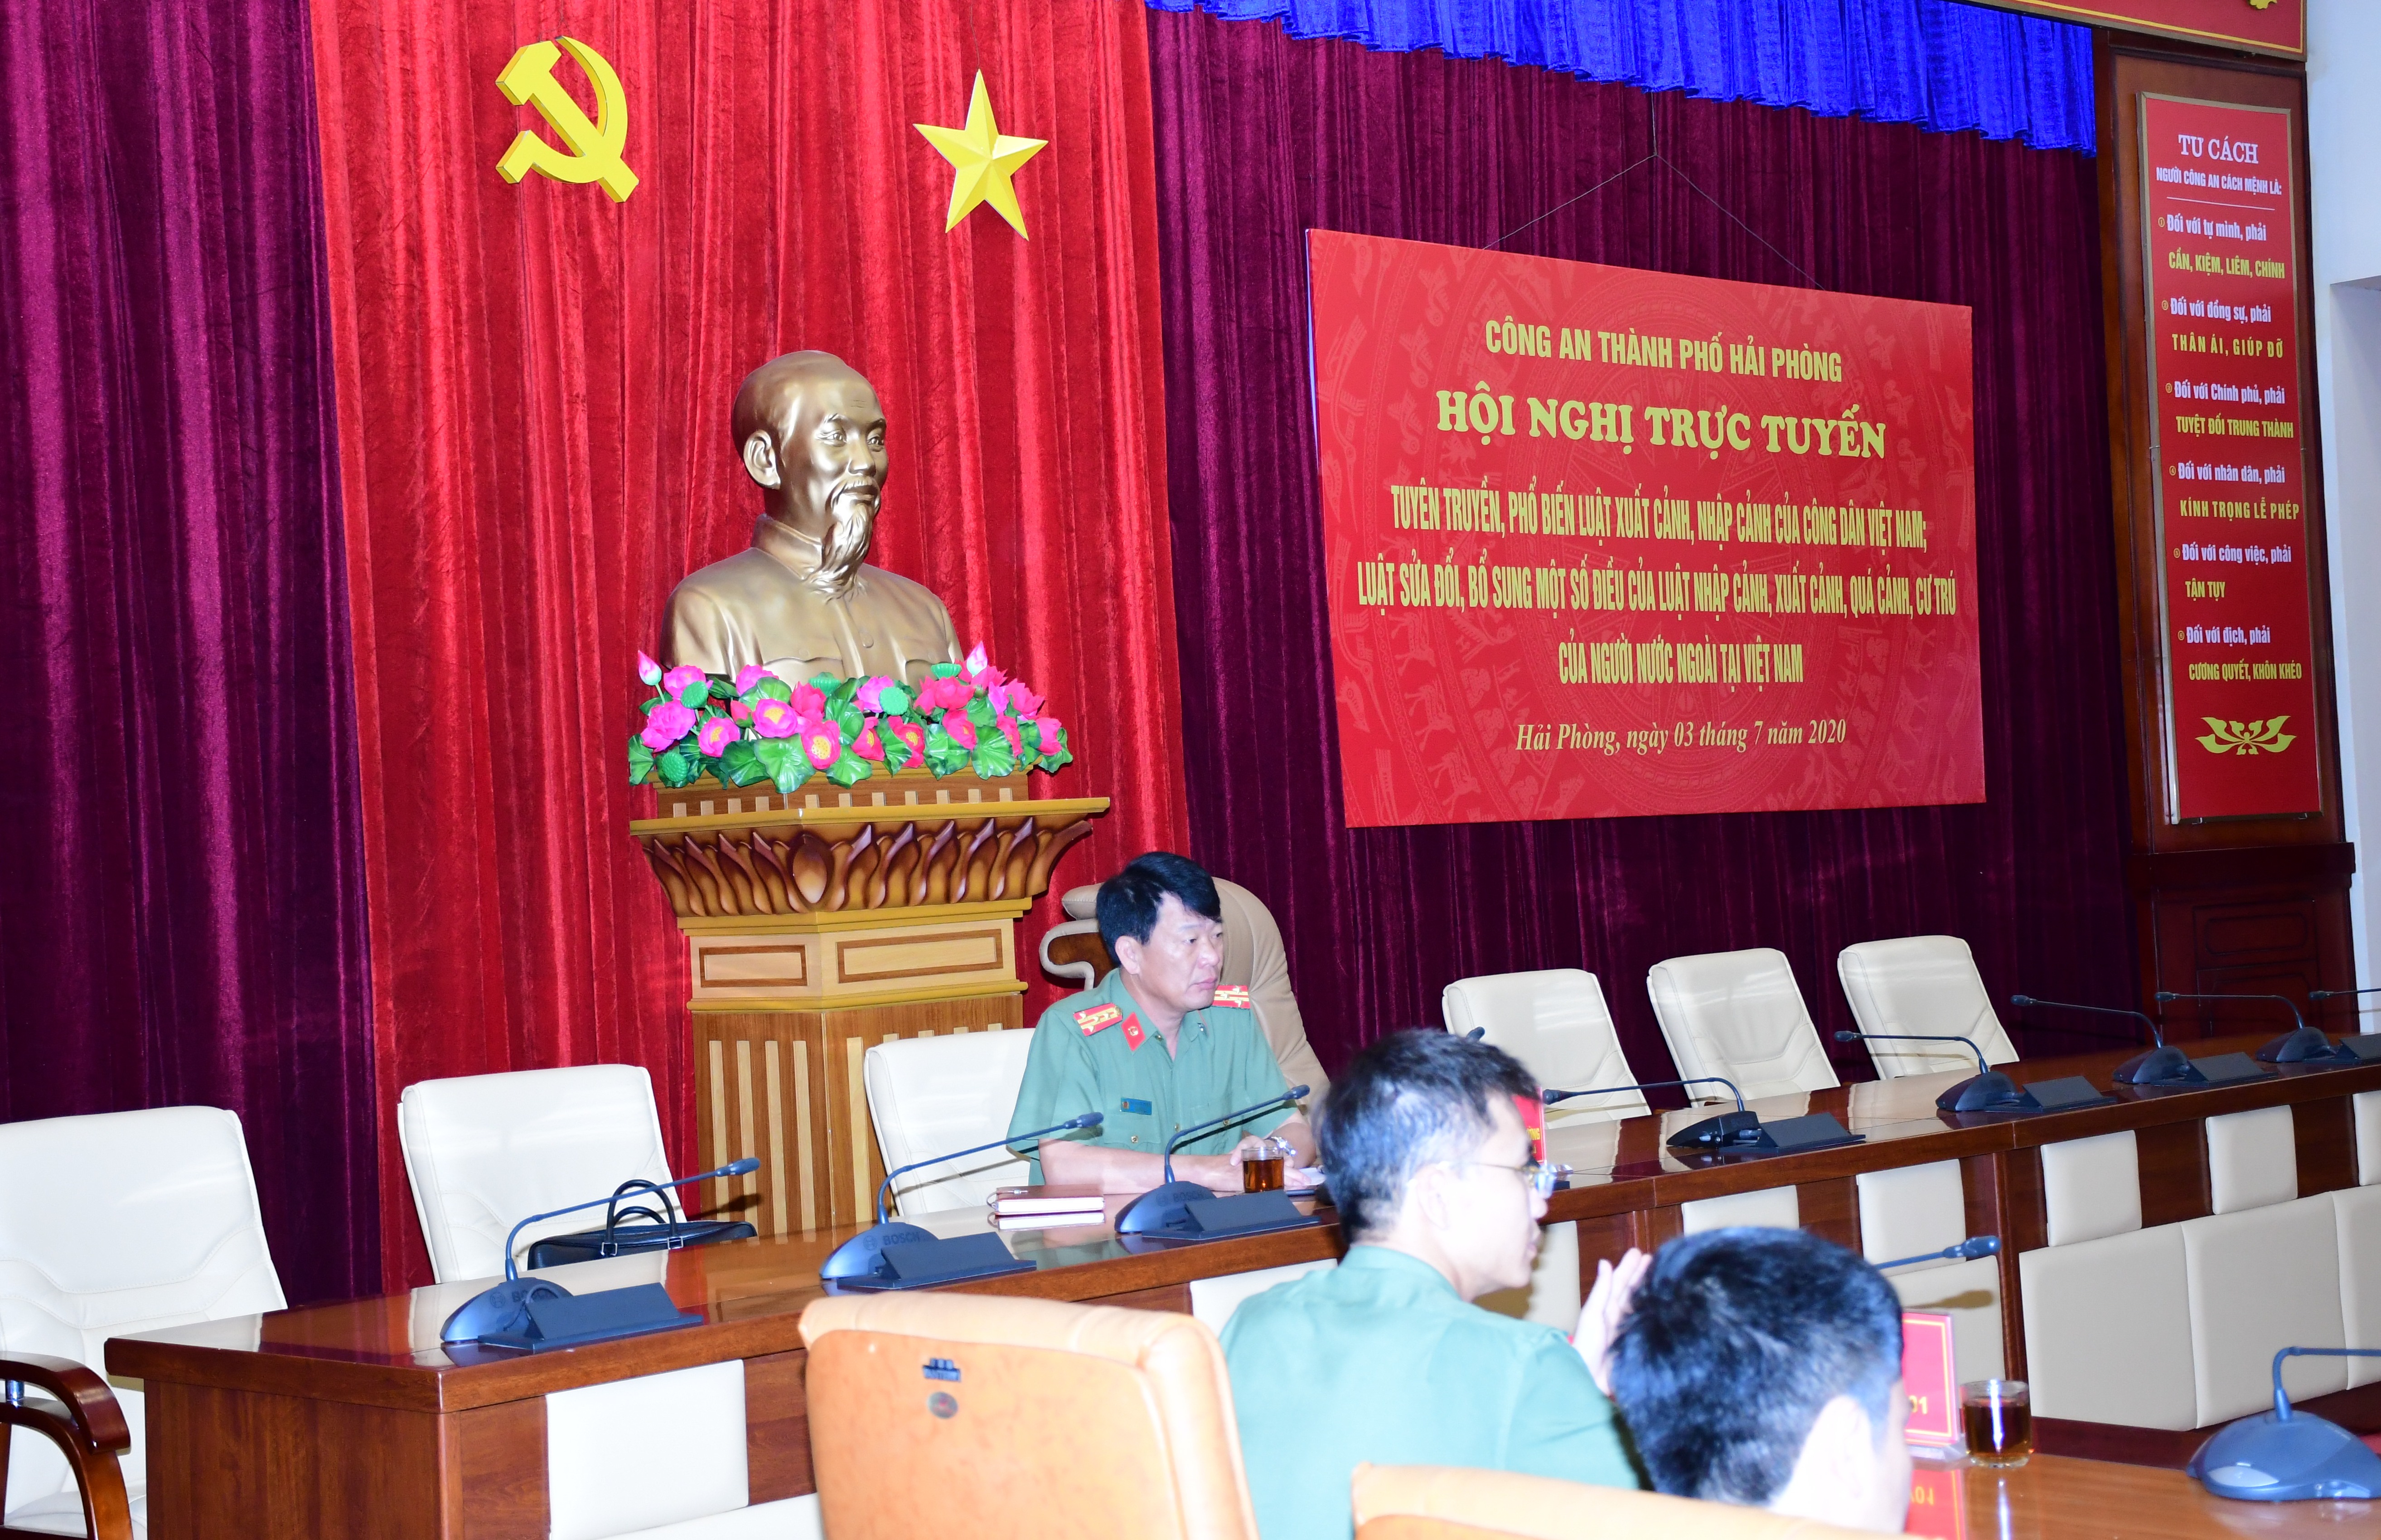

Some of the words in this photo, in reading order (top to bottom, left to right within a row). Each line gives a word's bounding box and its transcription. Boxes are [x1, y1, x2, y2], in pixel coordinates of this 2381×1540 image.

[2178, 134, 2204, 157] TƯ
[2208, 135, 2258, 164] CÁCH
[2156, 166, 2182, 183] NGƯỜI
[2183, 169, 2206, 187] CÔNG
[2208, 174, 2219, 188] AN
[2221, 174, 2243, 191] CÁCH
[2245, 176, 2268, 195] MỆNH
[2270, 179, 2281, 195] LÀ:
[2167, 213, 2183, 232] Đối
[2186, 217, 2201, 234] với
[2203, 219, 2213, 239] tự
[2216, 221, 2243, 241] mình,
[2245, 222, 2266, 241] phải
[2168, 247, 2192, 272] CẦN,
[2195, 252, 2223, 275] KIỆM,
[2226, 255, 2253, 278] LIÊM,
[2255, 258, 2285, 279] CHÍNH
[2170, 296, 2187, 315] Đối
[2189, 300, 2204, 317] với
[2207, 299, 2231, 321] đồng
[2234, 306, 2248, 323] sự,
[2250, 304, 2271, 323] phải
[1486, 315, 1551, 357] CÔNG
[1559, 328, 1591, 361] AN
[1598, 328, 1672, 368] THÀNH
[1679, 332, 1723, 372] PHỐ
[1730, 335, 1765, 376] HẢI
[1772, 343, 1841, 382] PHÒNG
[2172, 332, 2206, 352] THÂN
[2211, 334, 2228, 356] ÁI,
[2233, 337, 2262, 356] GIÚP
[2267, 338, 2283, 357] ĐỠ
[2174, 379, 2191, 398] Đối
[2193, 382, 2208, 399] với
[2211, 384, 2238, 401] Chính
[2241, 384, 2261, 404] phủ,
[2265, 386, 2284, 405] phải
[1436, 381, 1515, 445] HỘI
[1527, 398, 1634, 454] NGHỊ
[1645, 405, 1750, 459] TRỰC
[1761, 404, 1885, 458] TUYẾN
[2176, 414, 2205, 437] TUYỆT
[2208, 413, 2225, 434] ĐỐI
[2227, 420, 2260, 436] TRUNG
[2262, 419, 2293, 438] THÀNH
[2178, 461, 2194, 479] Đối
[2197, 463, 2212, 480] với
[2215, 464, 2238, 481] nhân
[2241, 466, 2261, 484] dân,
[2265, 465, 2285, 484] phải
[1391, 478, 1440, 530] TUYÊN
[1443, 476, 1505, 538] TRUYỀN,
[1509, 475, 1538, 534] PHỔ
[1541, 481, 1575, 535] BIẾN
[1578, 487, 1611, 546] LUẬT
[1615, 483, 1649, 538] XUẤT
[1654, 485, 1694, 545] CẢNH,
[1697, 493, 1732, 550] NHẬP
[1737, 490, 1771, 542] CẢNH
[1775, 492, 1800, 544] CỦA
[1804, 498, 1837, 545] CÔNG
[1840, 500, 1865, 546] DÂN
[1868, 501, 1892, 555] VIỆT
[1896, 510, 1926, 552] NAM;
[2180, 497, 2208, 517] KÍNH
[2212, 501, 2250, 521] TRỌNG
[2254, 497, 2266, 518] LỄ
[2270, 500, 2299, 519] PHÉP
[2183, 542, 2198, 560] Đối
[2201, 544, 2216, 560] với
[2219, 545, 2242, 563] công
[2245, 546, 2268, 565] việc,
[2271, 545, 2291, 564] phải
[1358, 553, 1394, 615] LUẬT
[1400, 549, 1431, 606] SỬA
[1434, 547, 1464, 613] ĐỔI,
[1468, 548, 1488, 608] BỔ
[1492, 566, 1532, 608] SUNG
[1536, 559, 1566, 618] MỘT
[1570, 554, 1589, 609] SỐ
[1593, 556, 1624, 610] ĐIỀU
[1628, 557, 1655, 611] CỦA
[1659, 563, 1689, 620] LUẬT
[1694, 564, 1729, 621] NHẬP
[1733, 560, 1771, 617] CẢNH,
[1775, 561, 1806, 613] XUẤT
[1810, 562, 1847, 618] CẢNH,
[1850, 569, 1874, 618] QUÁ
[1878, 564, 1913, 619] CẢNH,
[1916, 574, 1931, 614] CƯ
[1934, 570, 1955, 614] TRÚ
[2185, 578, 2205, 601] TẬN
[2207, 582, 2225, 601] TỤY
[2187, 624, 2203, 643] Đối
[2205, 627, 2220, 643] với
[2223, 627, 2247, 647] địch,
[2250, 625, 2270, 645] phải
[1559, 628, 1587, 684] CỦA
[1591, 633, 1633, 684] NGƯỜI
[1636, 634, 1673, 683] NƯỚC
[1677, 635, 1717, 683] NGOÀI
[1720, 644, 1741, 692] TẠI
[1743, 636, 1770, 691] VIỆT
[1774, 644, 1803, 682] NAM
[2189, 662, 2220, 680] CƯƠNG
[2222, 659, 2250, 681] QUYẾT,
[2253, 661, 2277, 679] KHÔN
[2279, 660, 2301, 679] KHÉO
[1515, 724, 1550, 750] Hải
[1556, 724, 1620, 755] Phòng,
[1627, 723, 1668, 755] ngày
[1674, 722, 1693, 746] 03
[1700, 722, 1747, 752] tháng
[1755, 721, 1763, 744] 7
[1768, 721, 1802, 744] năm
[1809, 719, 1845, 743] 2020
